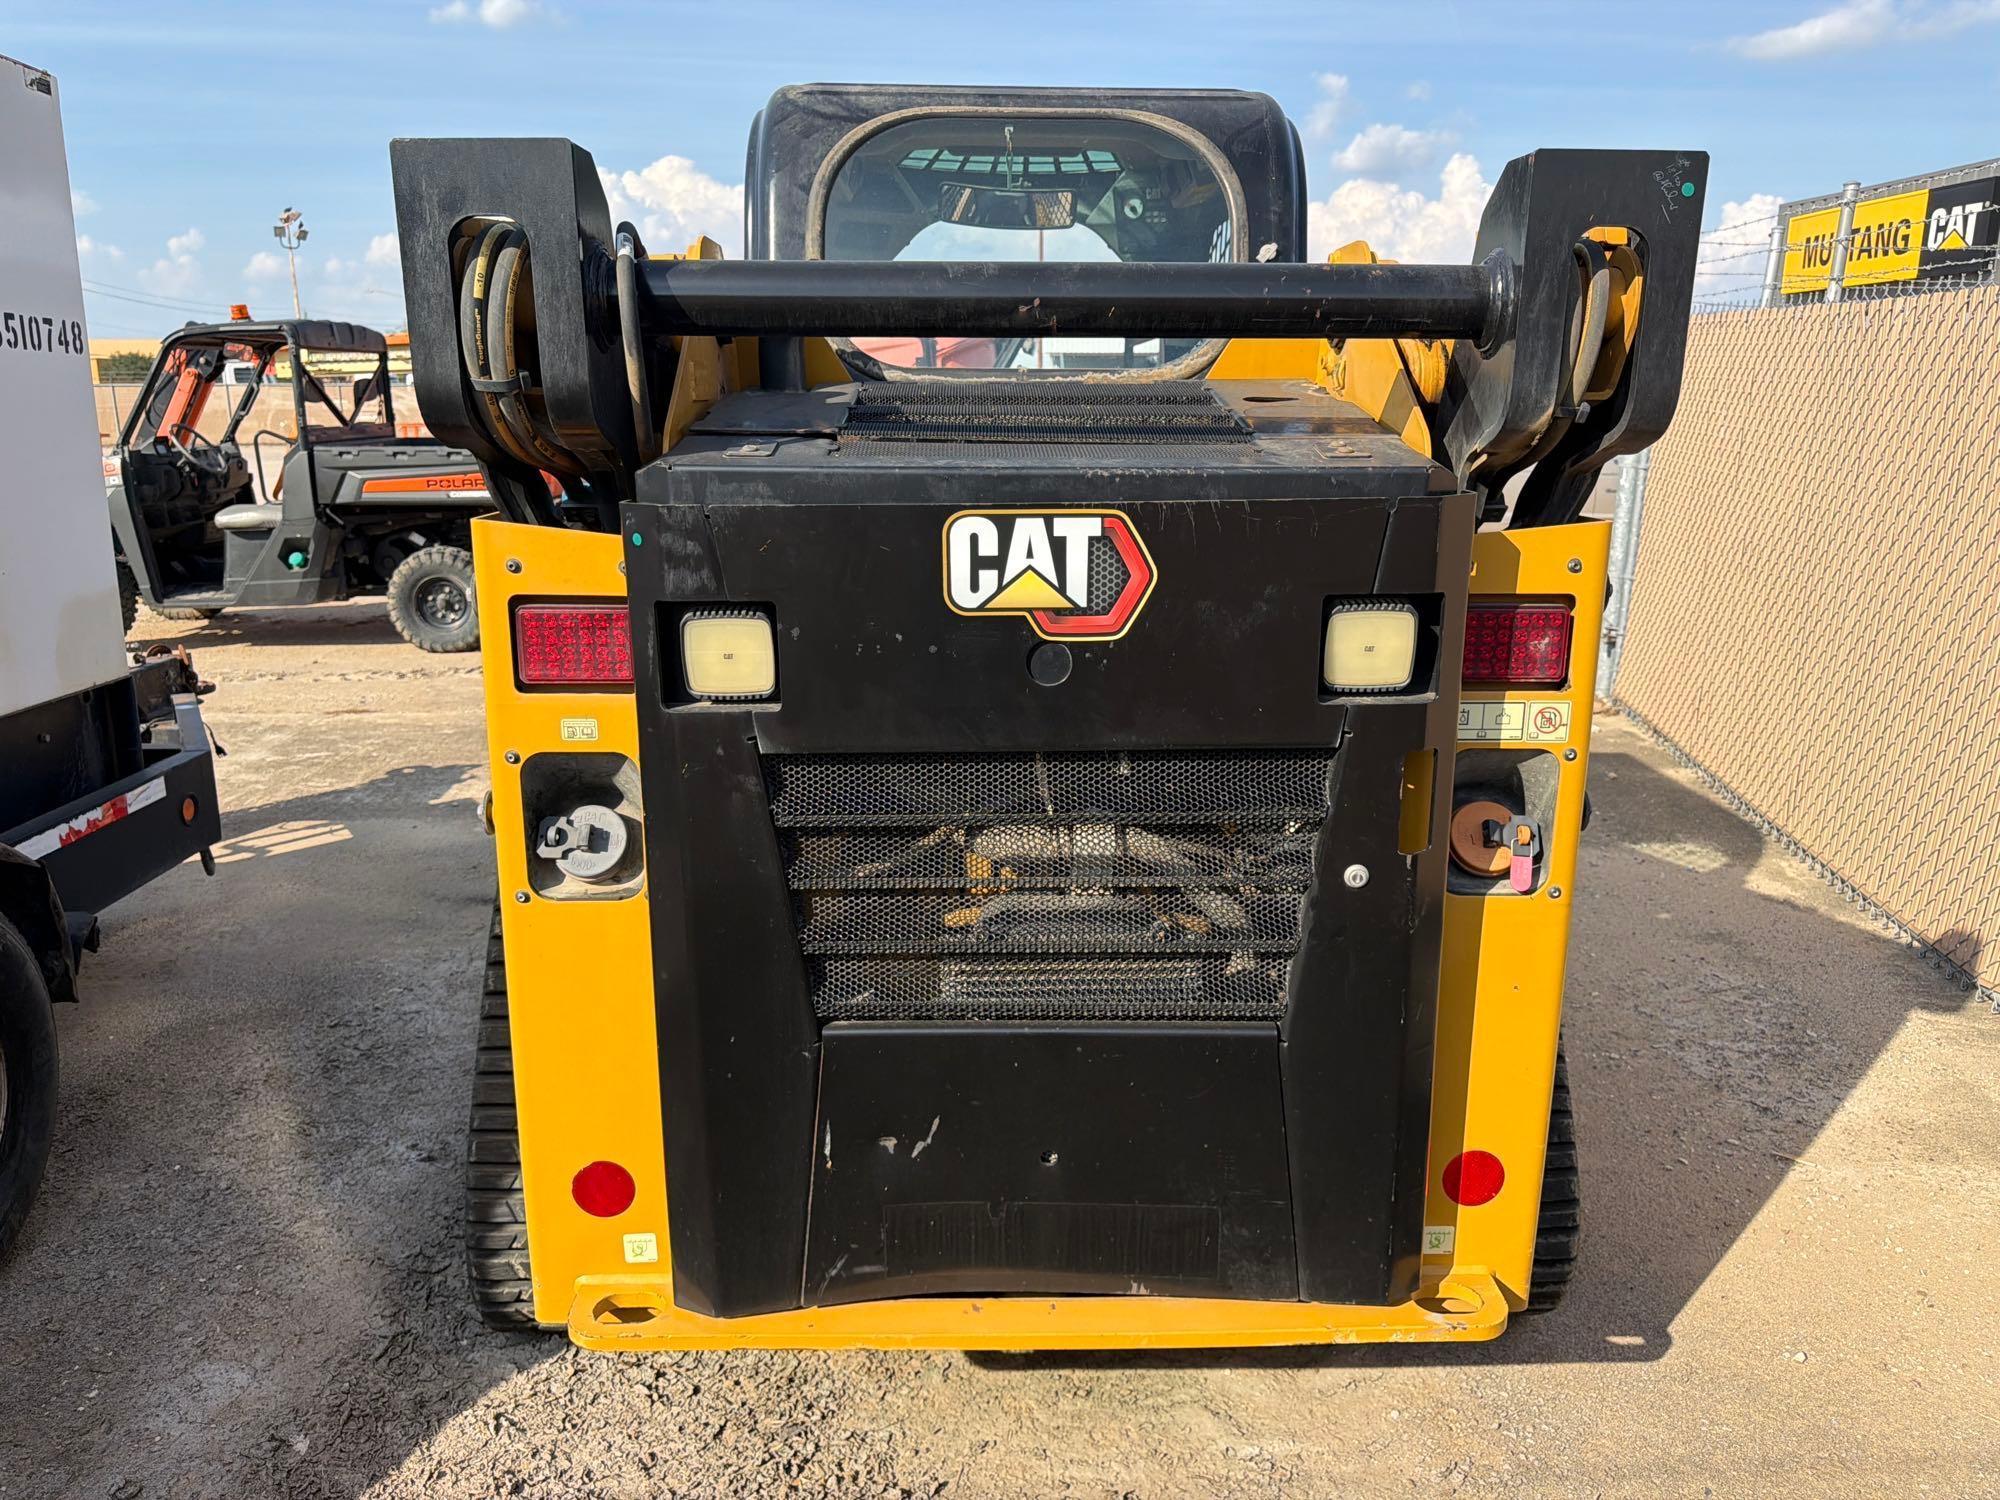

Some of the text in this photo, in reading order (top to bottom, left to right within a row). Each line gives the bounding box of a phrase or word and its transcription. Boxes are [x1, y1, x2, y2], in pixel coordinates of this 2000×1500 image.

[1802, 202, 1984, 269] MUTANG CAT
[949, 516, 1102, 609] CAT
